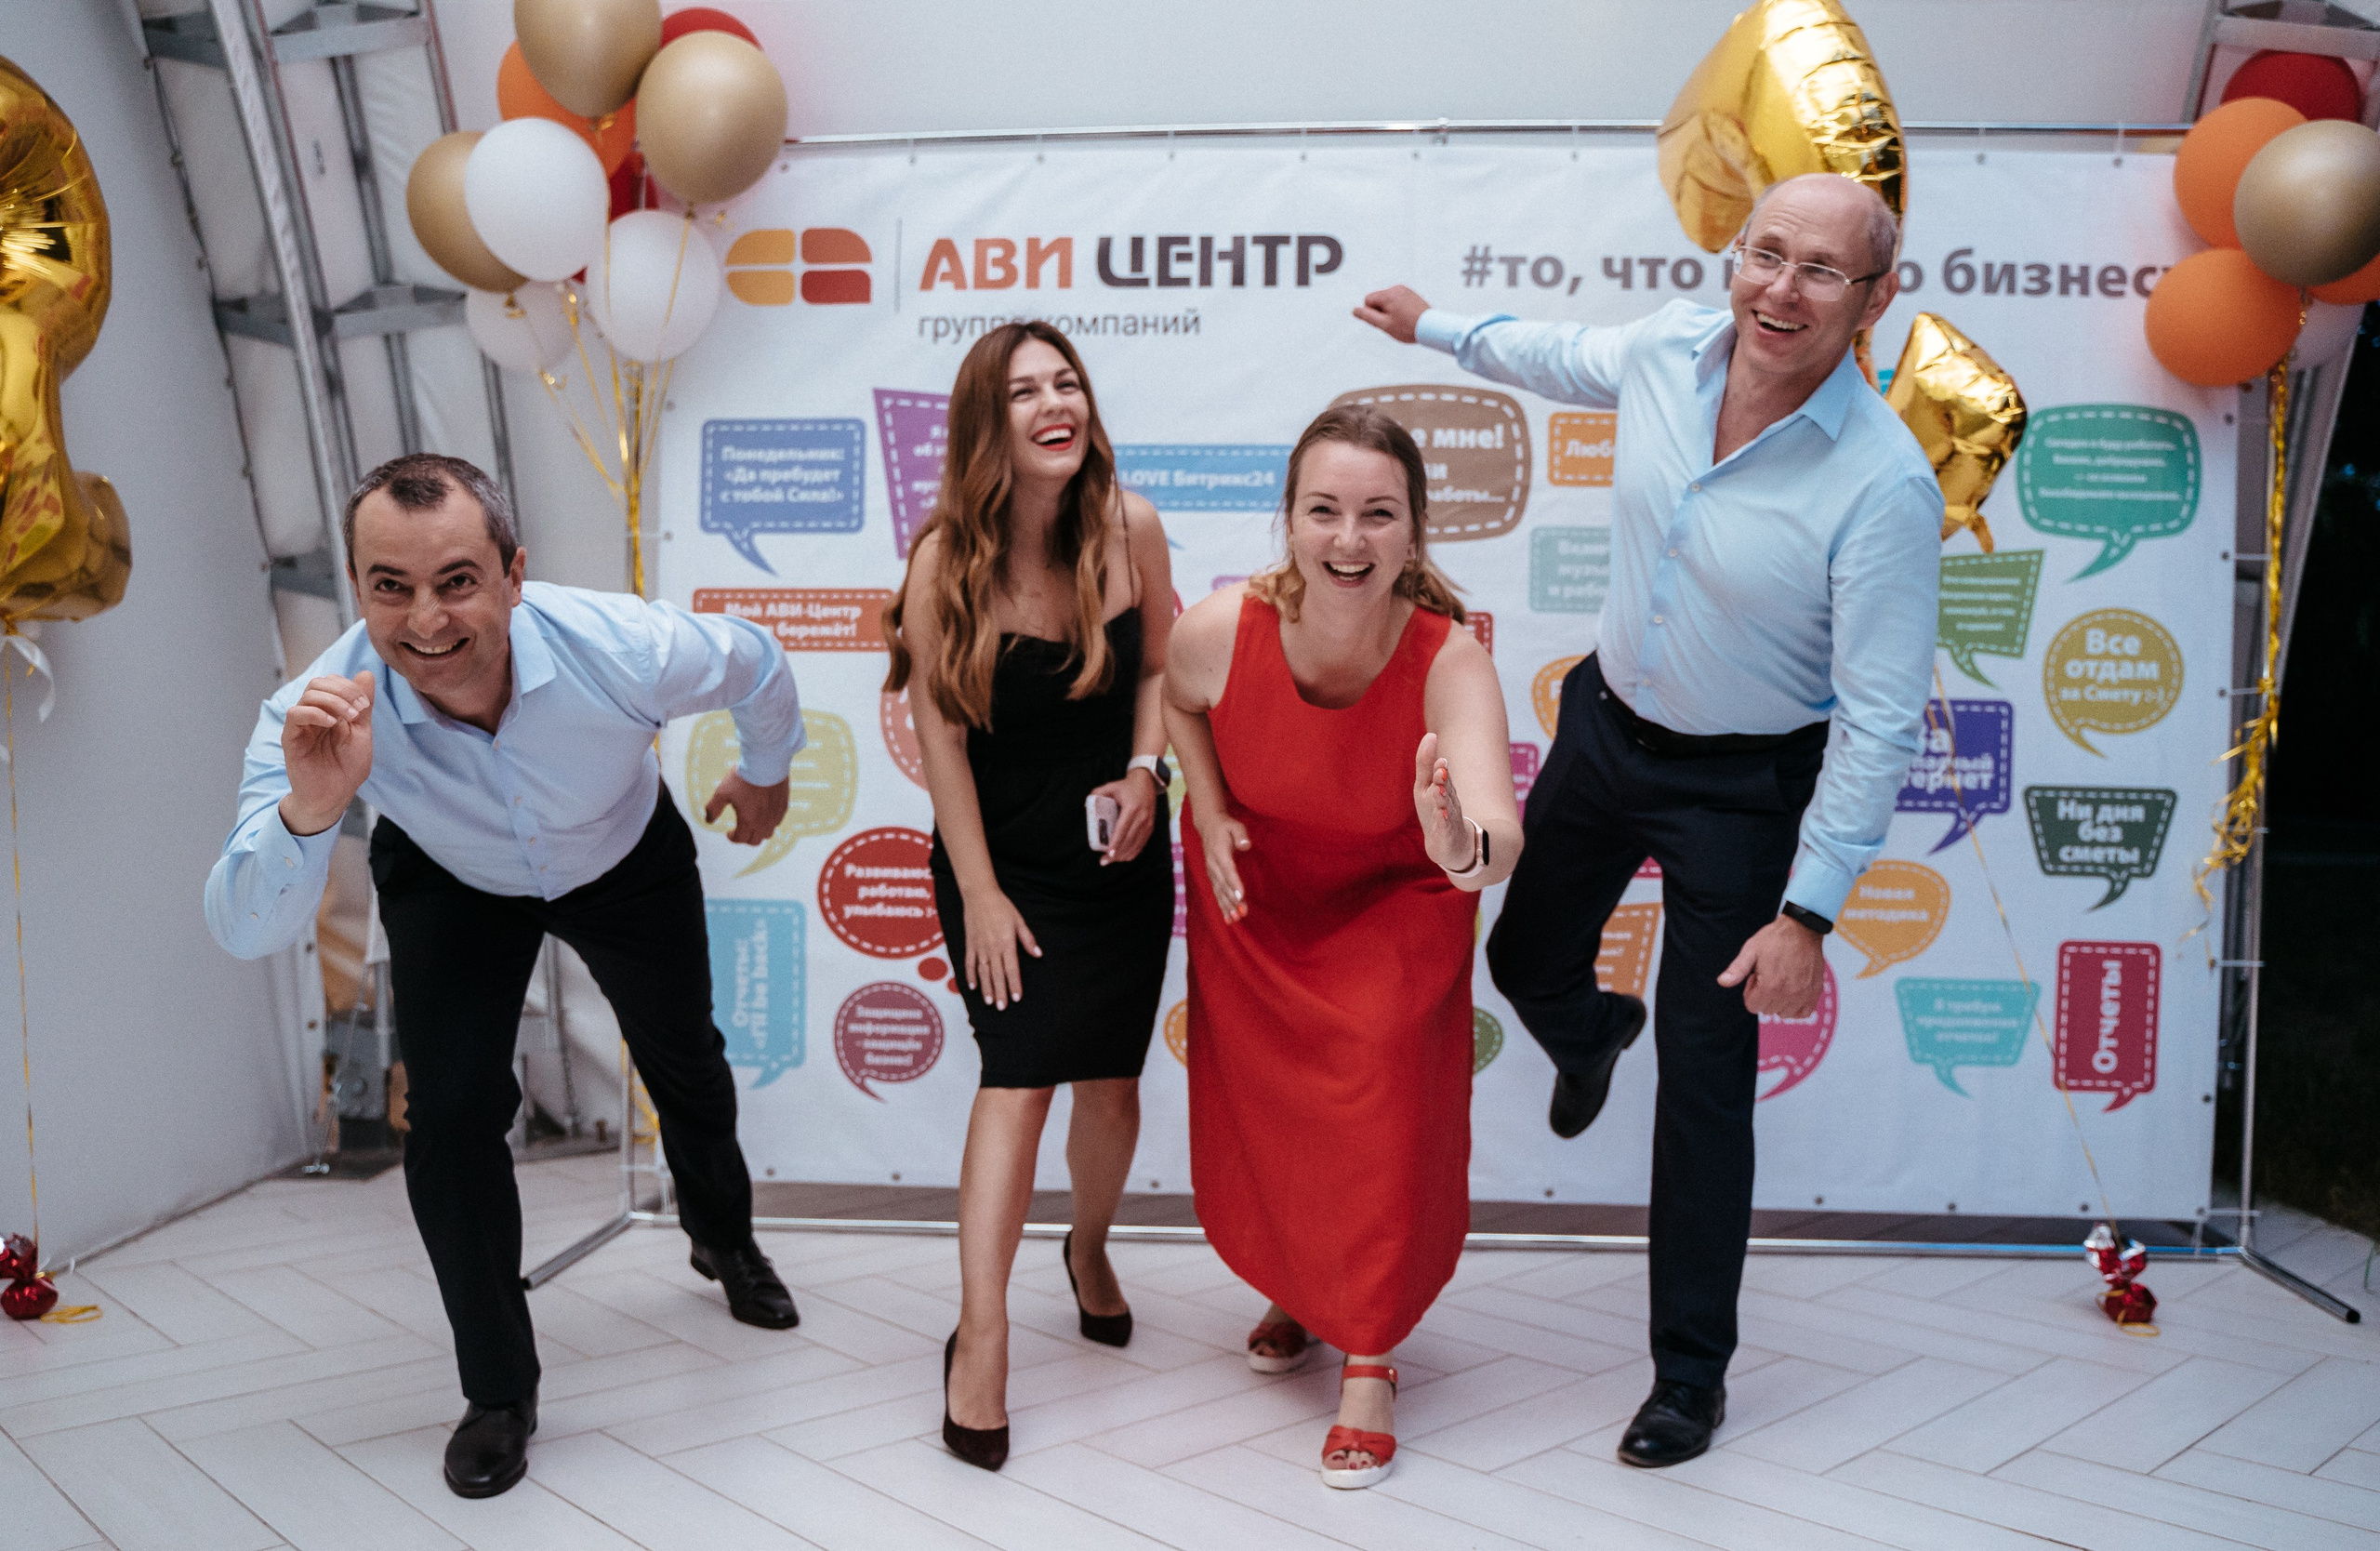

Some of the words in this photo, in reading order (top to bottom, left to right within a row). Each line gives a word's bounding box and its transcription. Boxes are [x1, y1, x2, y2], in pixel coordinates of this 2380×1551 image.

[919, 236, 1073, 291] АВИ
[1097, 234, 1344, 288] ЦЕНТР
[1461, 245, 1583, 297] #то,
[1603, 257, 1703, 291] что
[1943, 247, 2172, 298] бизнес
[1039, 308, 1201, 338] омпаний
[1433, 424, 1504, 449] мне!
[721, 444, 845, 463] Понедельник:
[723, 465, 757, 484] «Да
[759, 467, 840, 485] пребудет
[1120, 470, 1170, 486] LOVE
[1172, 469, 1276, 490] Битрикс24
[732, 486, 785, 503] тобой
[787, 486, 845, 503] Сила!»
[2085, 628, 2141, 656] Все
[2064, 659, 2161, 684] отдам
[1903, 771, 1995, 794] ернет
[2056, 798, 2093, 821] Ни
[2096, 803, 2146, 826] дня
[2077, 820, 2123, 842] без
[2057, 845, 2140, 864] сметы
[857, 882, 931, 900] работаю,
[842, 903, 924, 919] улыбаюсь
[2092, 960, 2122, 1073] Отчеты
